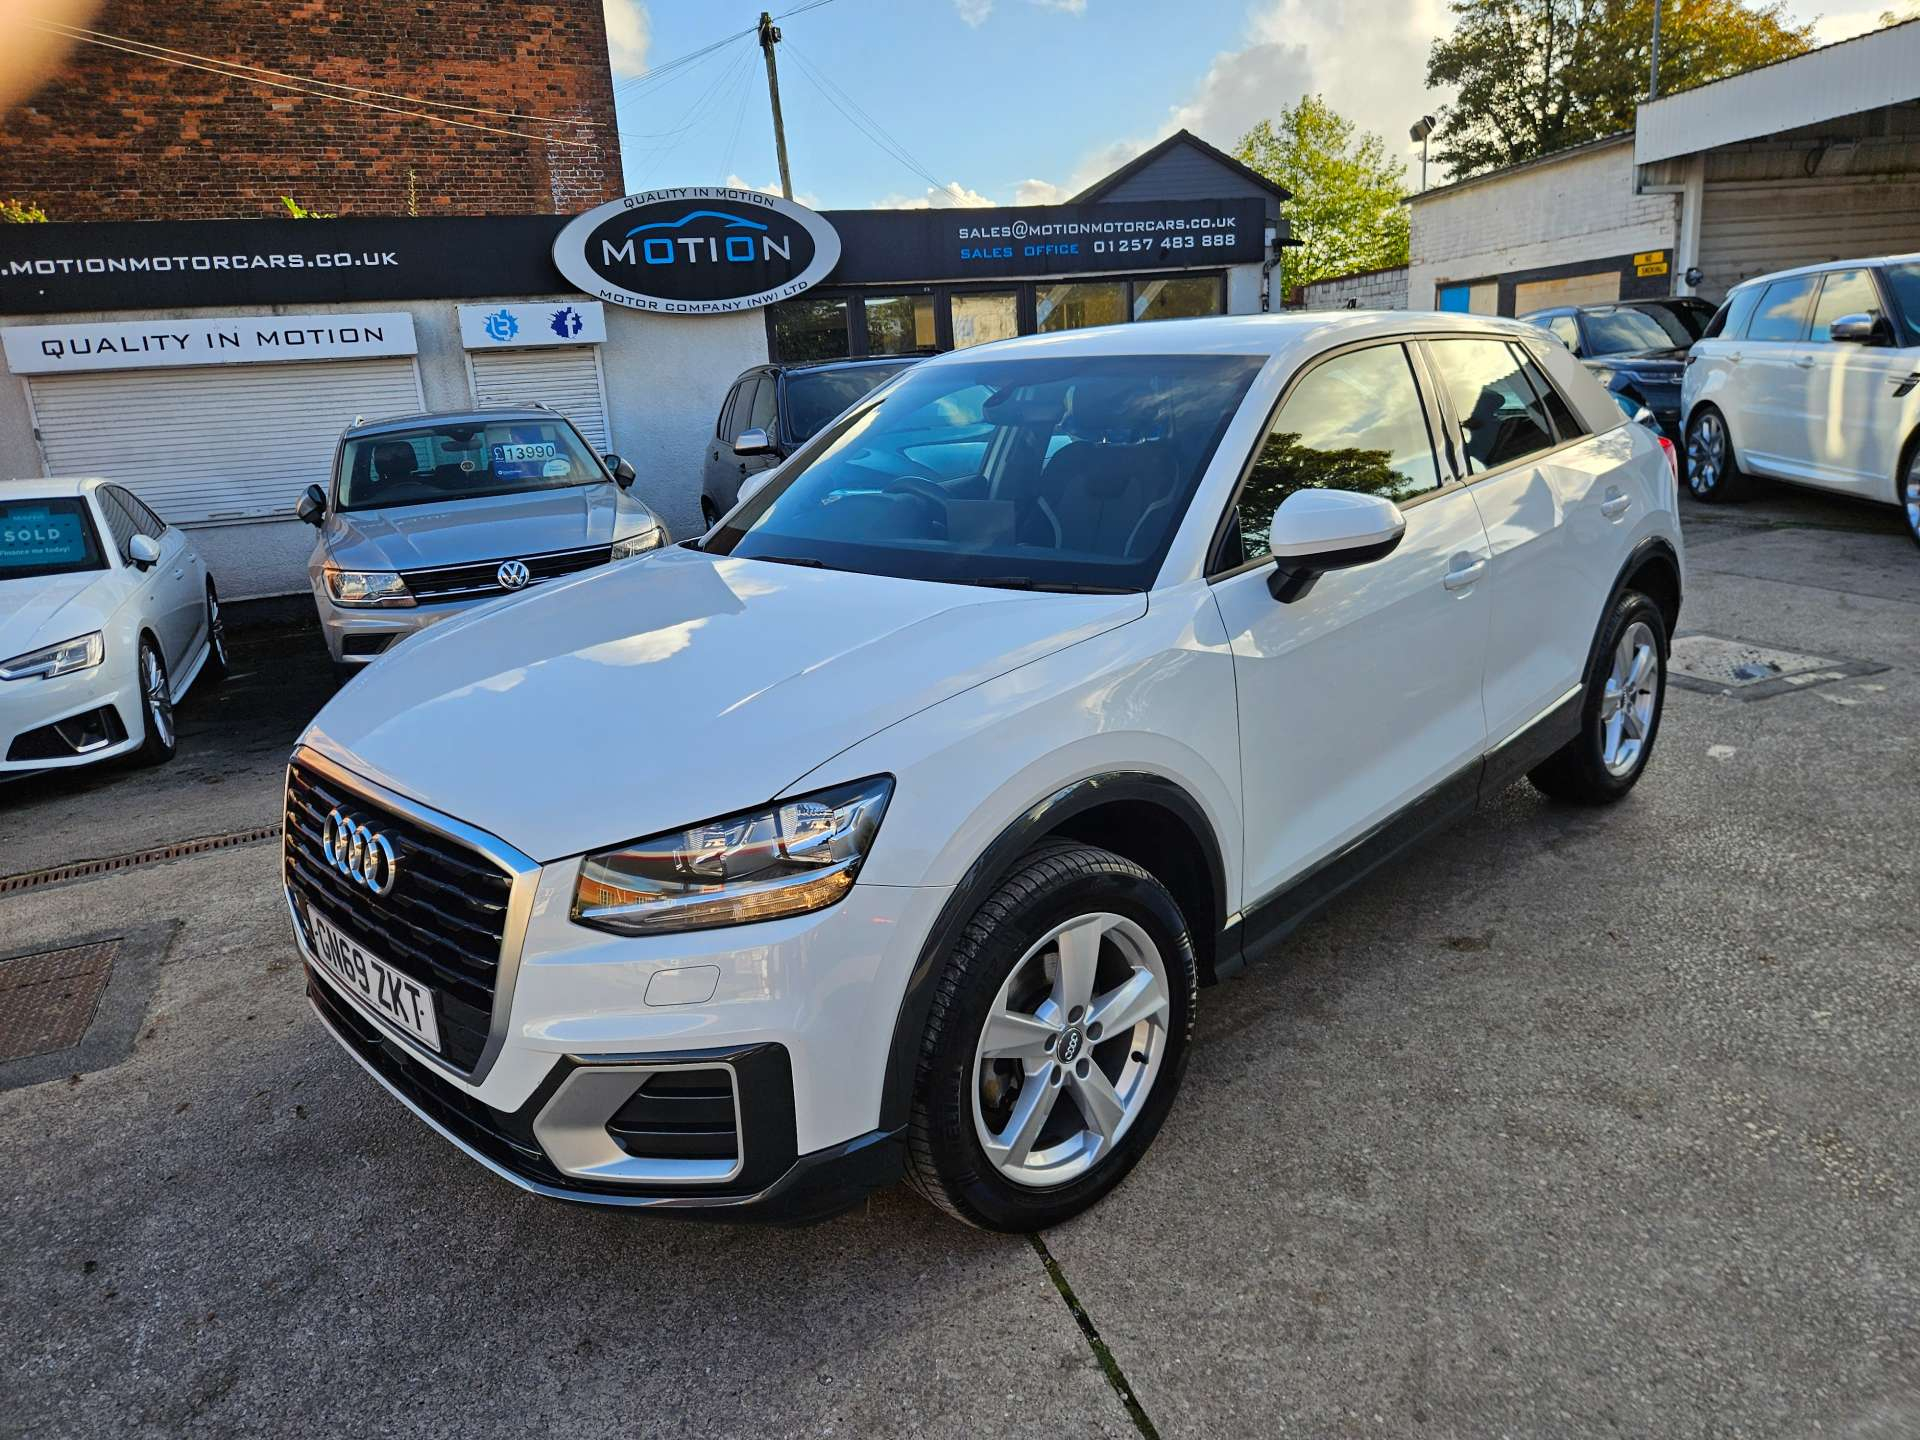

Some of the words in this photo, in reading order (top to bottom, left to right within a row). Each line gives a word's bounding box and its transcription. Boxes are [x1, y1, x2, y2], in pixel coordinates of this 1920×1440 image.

[624, 188, 687, 208] QUALITY
[694, 188, 709, 197] IN
[716, 188, 774, 207] MOTION
[959, 217, 1236, 239] SALES@MOTIONMOTORCARS.CO.UK
[601, 235, 790, 266] MOTION
[960, 247, 1013, 259] SALES
[1024, 243, 1079, 257] OFFICE
[1093, 239, 1153, 253] 01257
[1160, 236, 1194, 249] 483
[1201, 234, 1236, 247] 888
[600, 289, 658, 310] MOTOR
[665, 301, 741, 312] COMPANY
[747, 292, 778, 308] (NW)
[783, 281, 808, 296] LTD
[41, 334, 190, 359] QUALITY
[207, 332, 240, 349] IN
[257, 327, 384, 346] MOTION
[4, 529, 60, 542] SOLD
[316, 918, 370, 994] GN69
[371, 960, 422, 1031] ZKT
